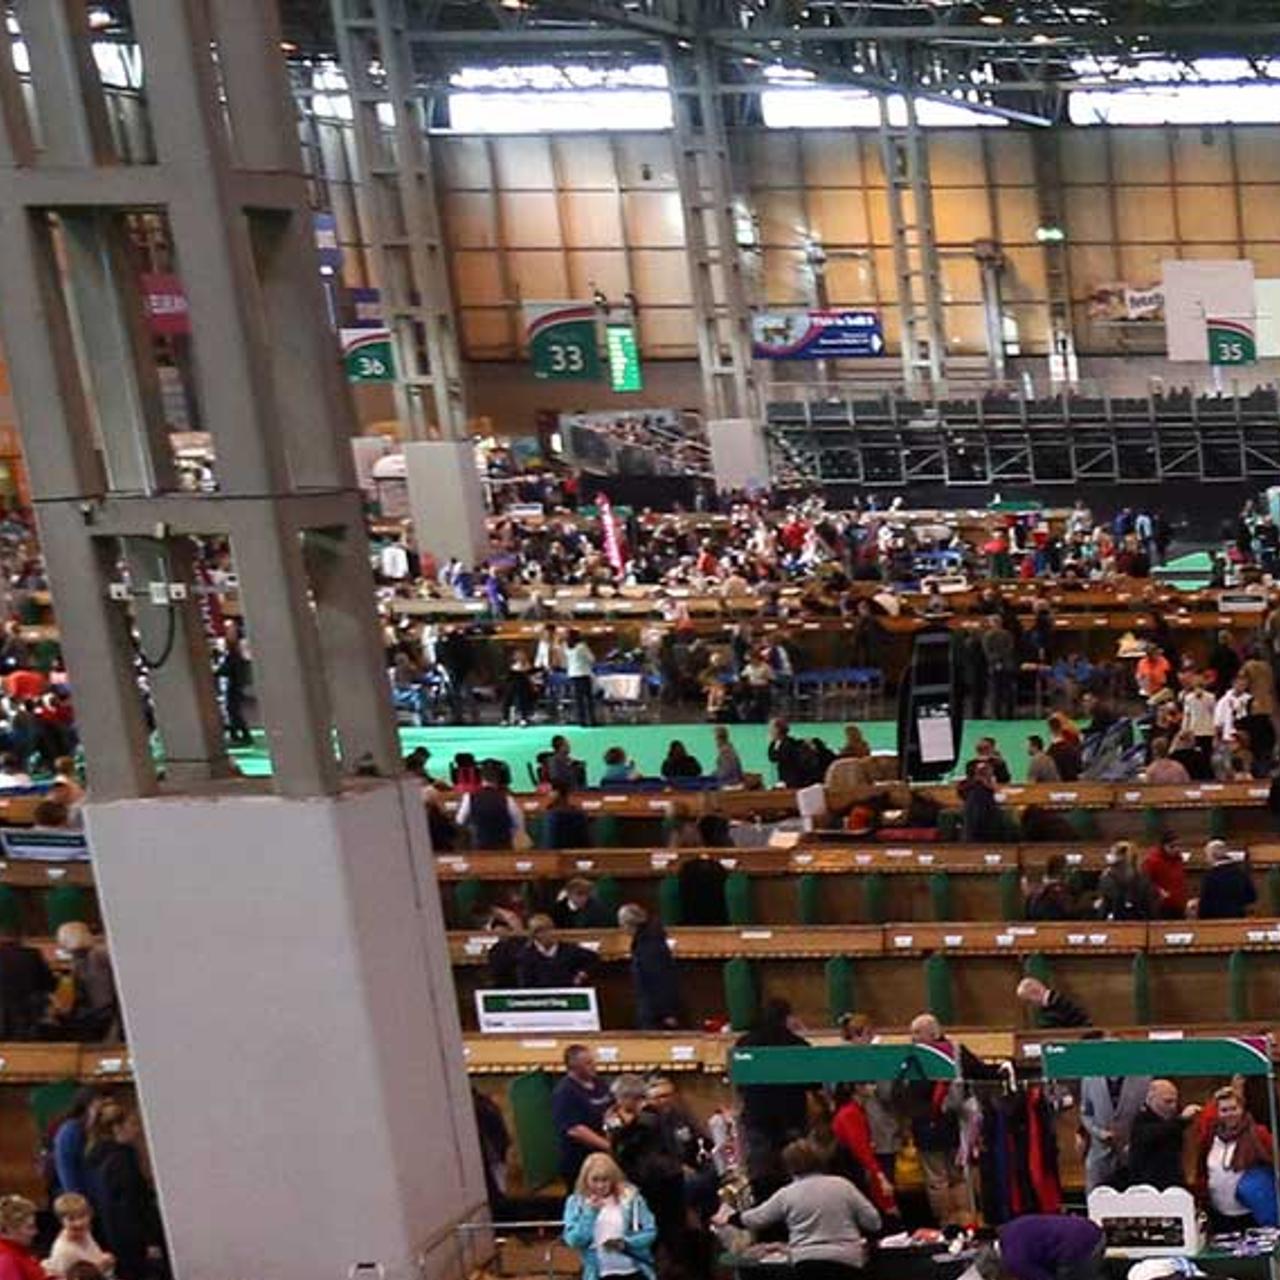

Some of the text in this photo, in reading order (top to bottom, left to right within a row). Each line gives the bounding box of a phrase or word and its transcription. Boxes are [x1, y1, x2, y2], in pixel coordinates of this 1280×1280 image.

[548, 345, 584, 371] 33
[1218, 343, 1243, 361] 35
[359, 357, 386, 377] 36
